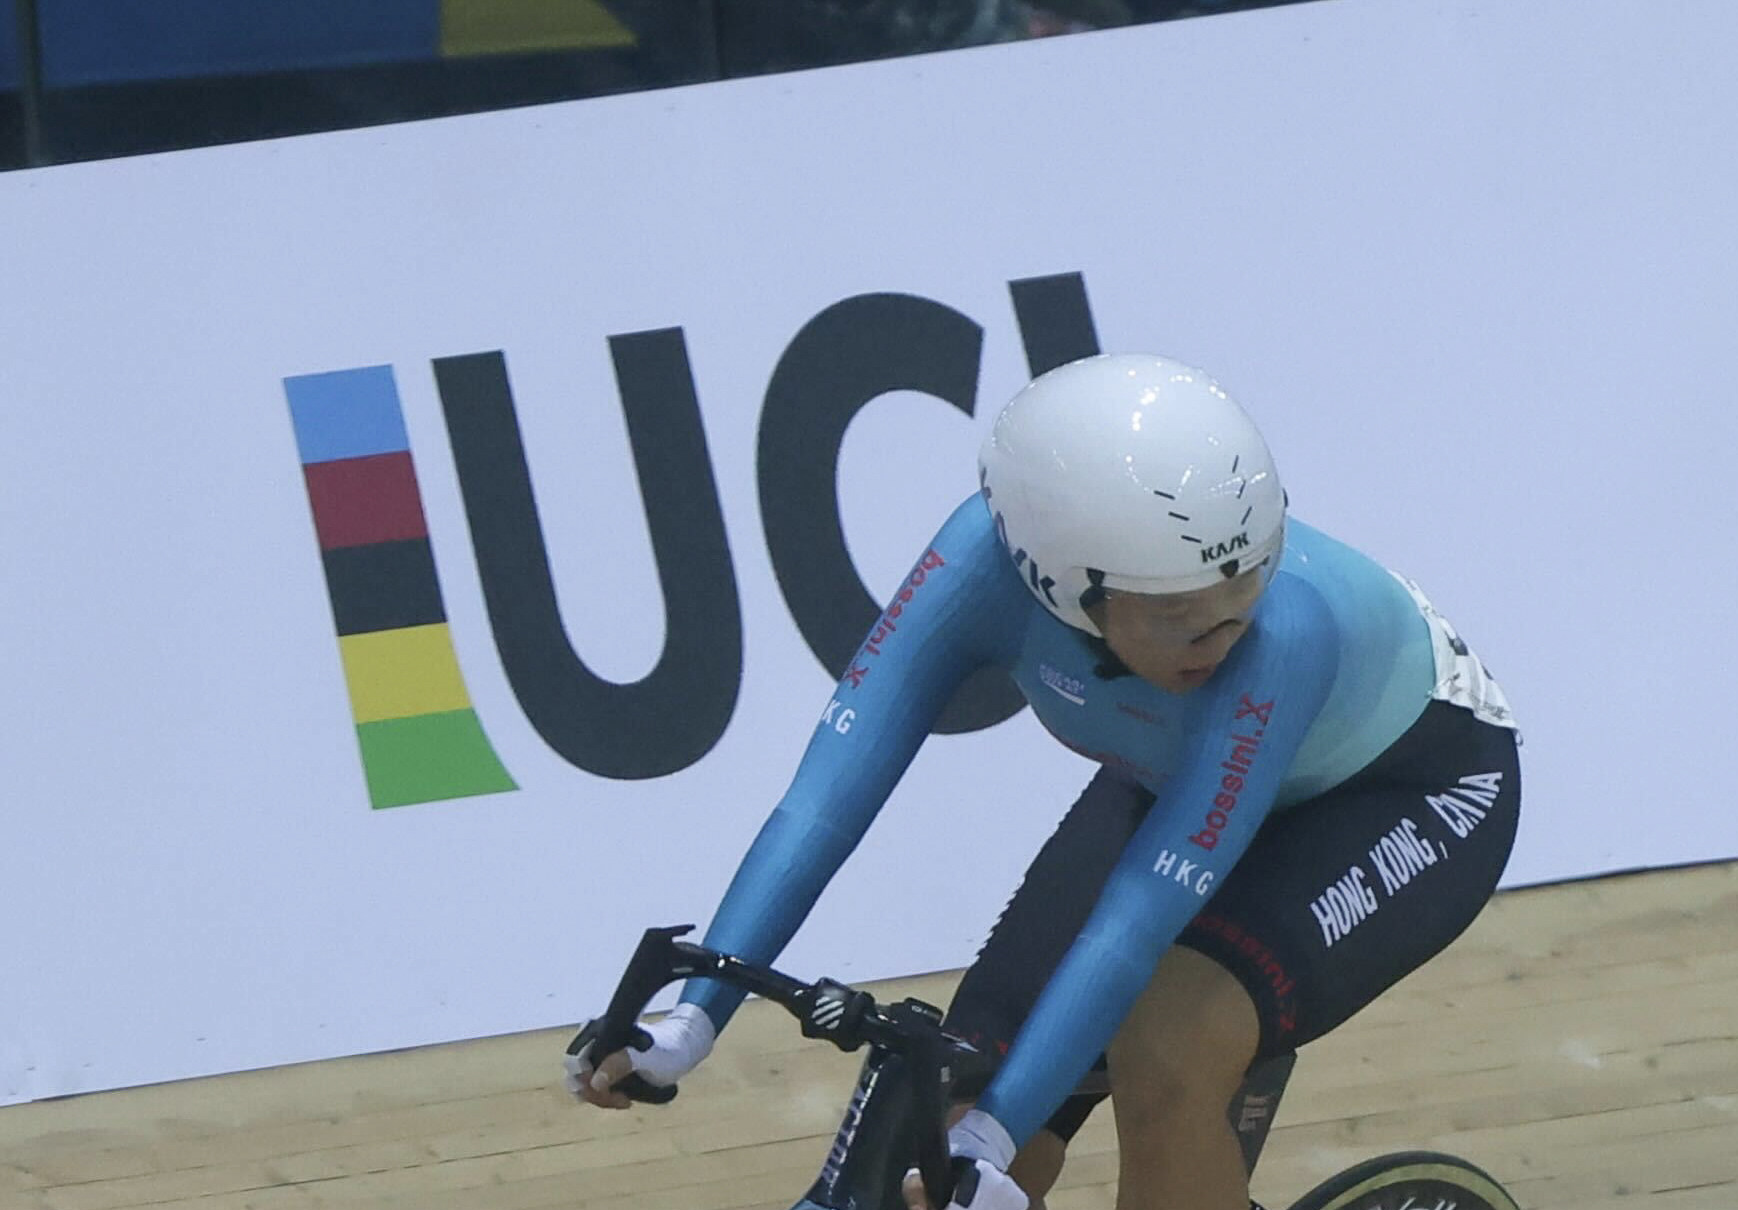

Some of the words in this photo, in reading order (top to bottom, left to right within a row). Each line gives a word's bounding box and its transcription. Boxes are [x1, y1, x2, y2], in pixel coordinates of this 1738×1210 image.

[821, 699, 856, 735] KG
[1153, 849, 1216, 897] HKG
[1310, 865, 1380, 949] HONG
